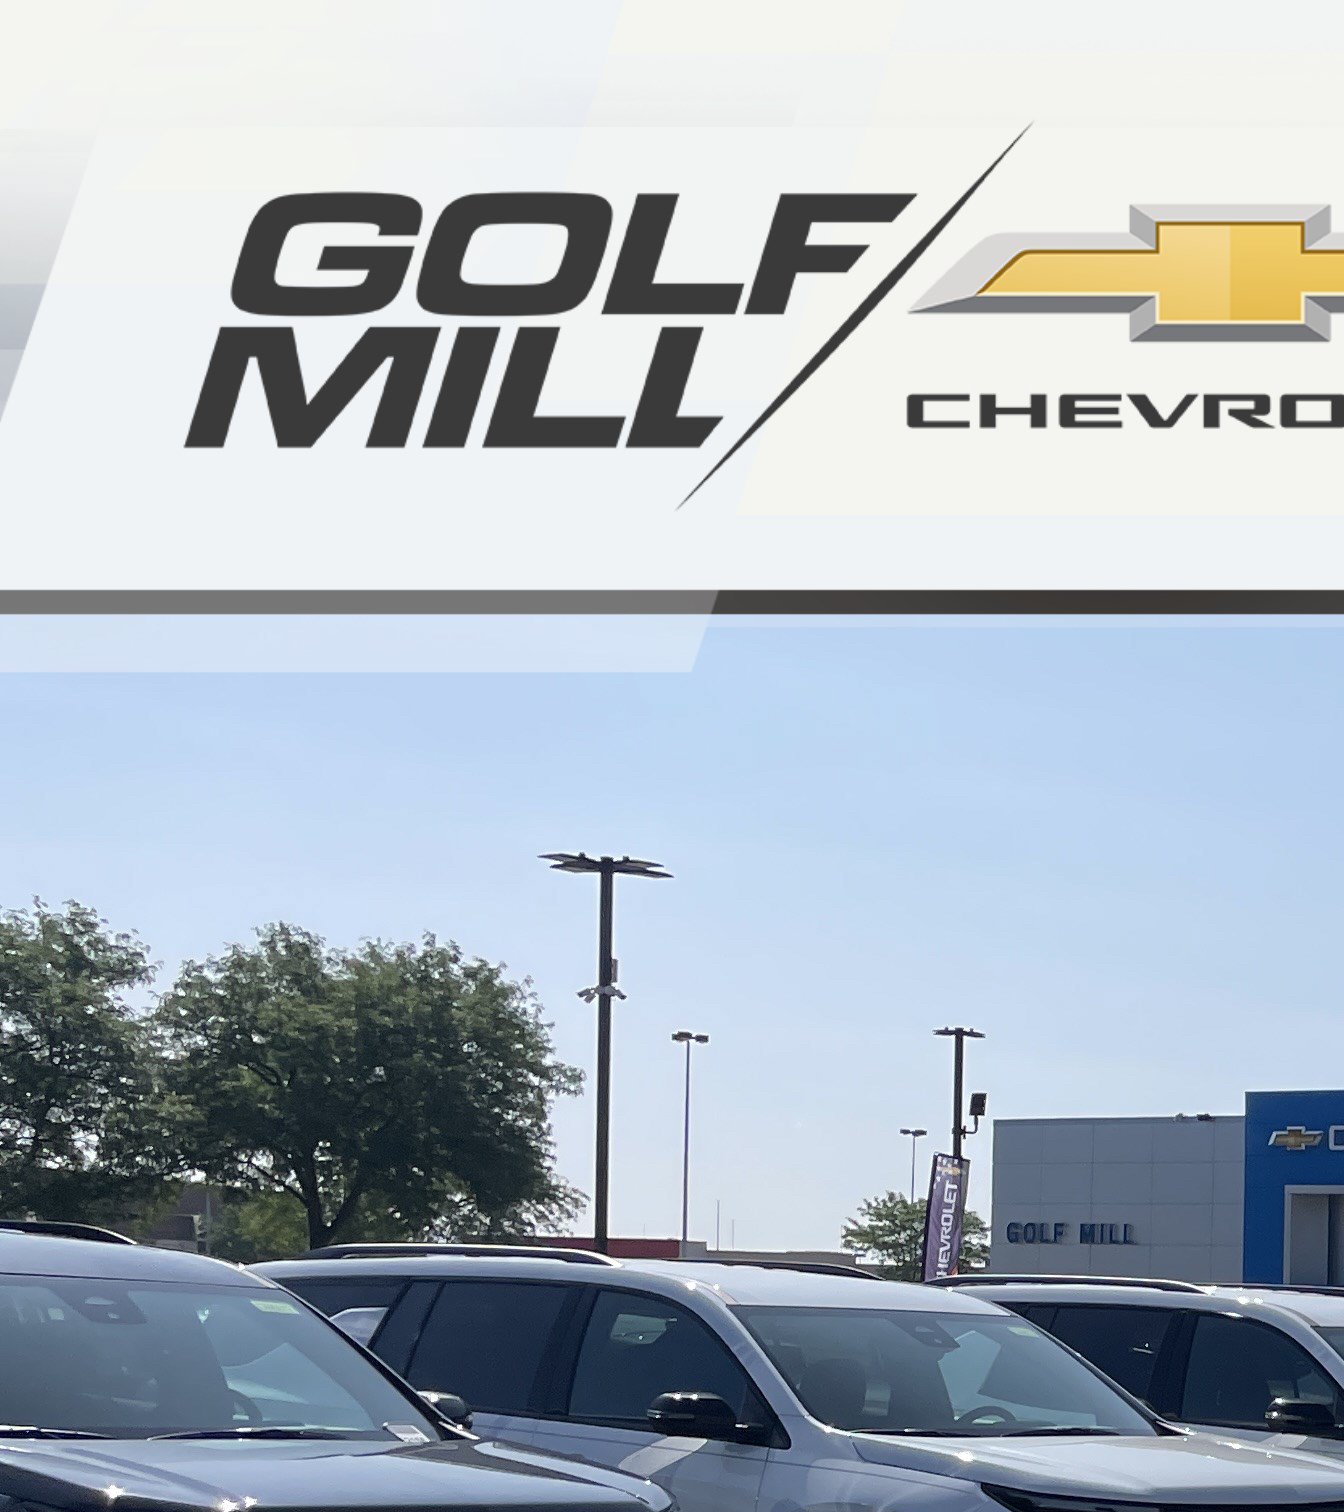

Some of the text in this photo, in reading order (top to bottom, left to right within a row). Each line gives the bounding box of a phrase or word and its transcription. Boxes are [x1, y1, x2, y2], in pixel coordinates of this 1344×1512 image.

[936, 1180, 958, 1278] HEVROLET
[1006, 1222, 1138, 1245] GOLF MILL
